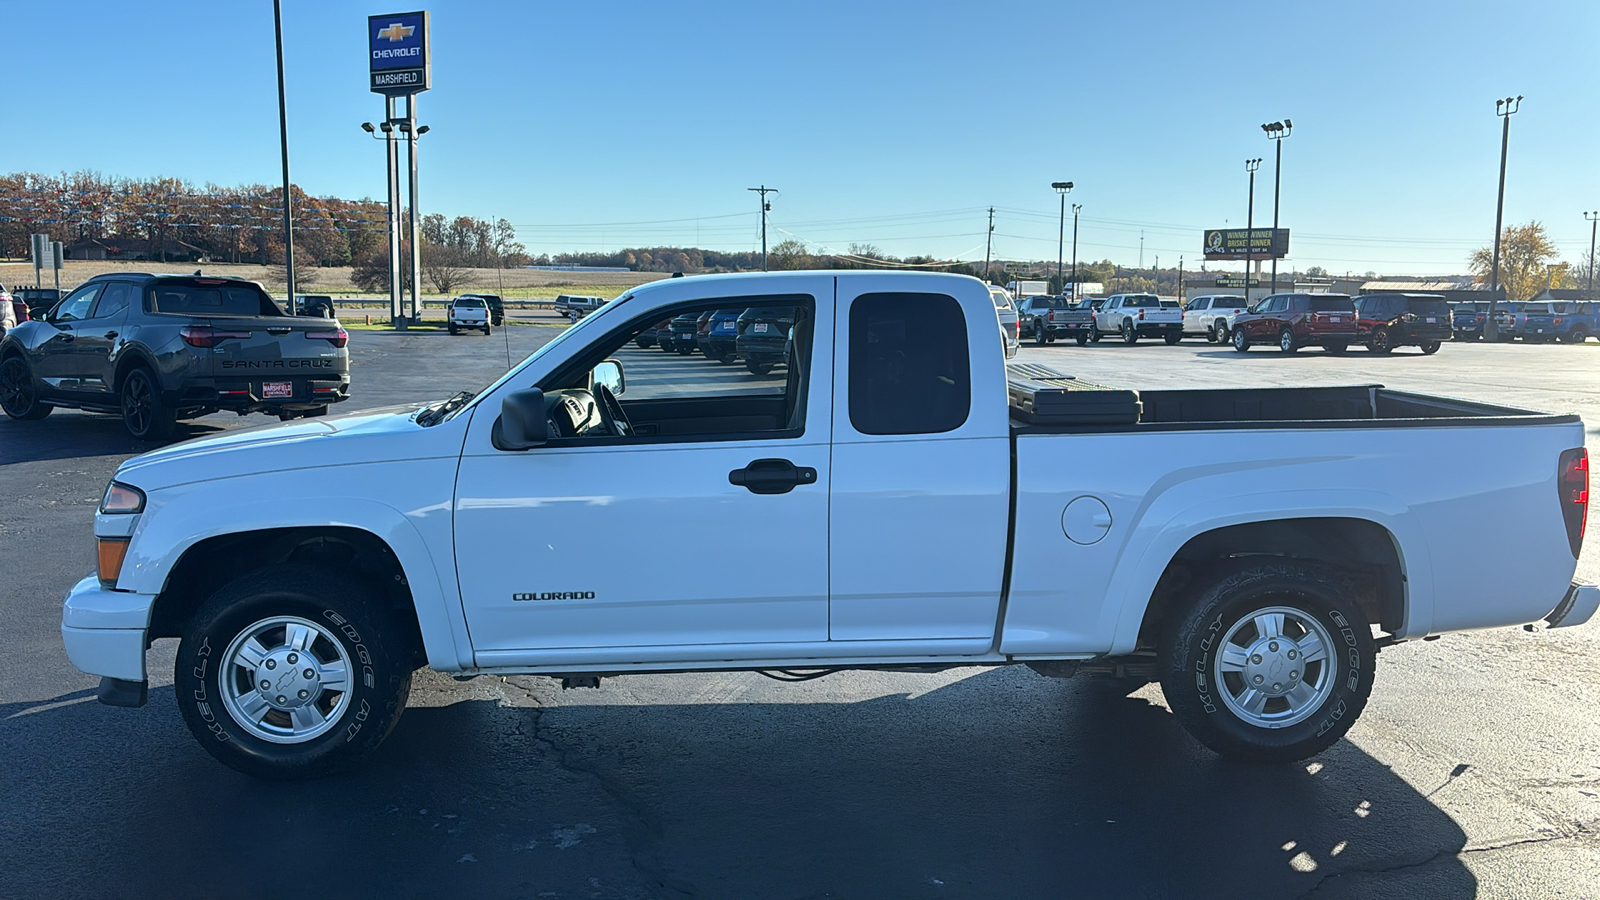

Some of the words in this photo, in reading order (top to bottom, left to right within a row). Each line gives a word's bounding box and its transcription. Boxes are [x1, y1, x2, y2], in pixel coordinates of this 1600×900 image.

[373, 47, 420, 59] CHEVROLET
[375, 73, 418, 85] MARSHFIELD
[1226, 231, 1248, 239] WINNER
[1250, 239, 1271, 247] DINNER
[222, 360, 284, 368] SANTA
[289, 360, 333, 368] CRUZ
[512, 591, 595, 601] COLORADO
[323, 609, 374, 689] EDGE
[1329, 610, 1360, 692] EDGE
[1196, 613, 1223, 714] KELLY
[194, 637, 230, 742] KELLY
[346, 698, 371, 742] AT
[1317, 699, 1347, 738] AT
